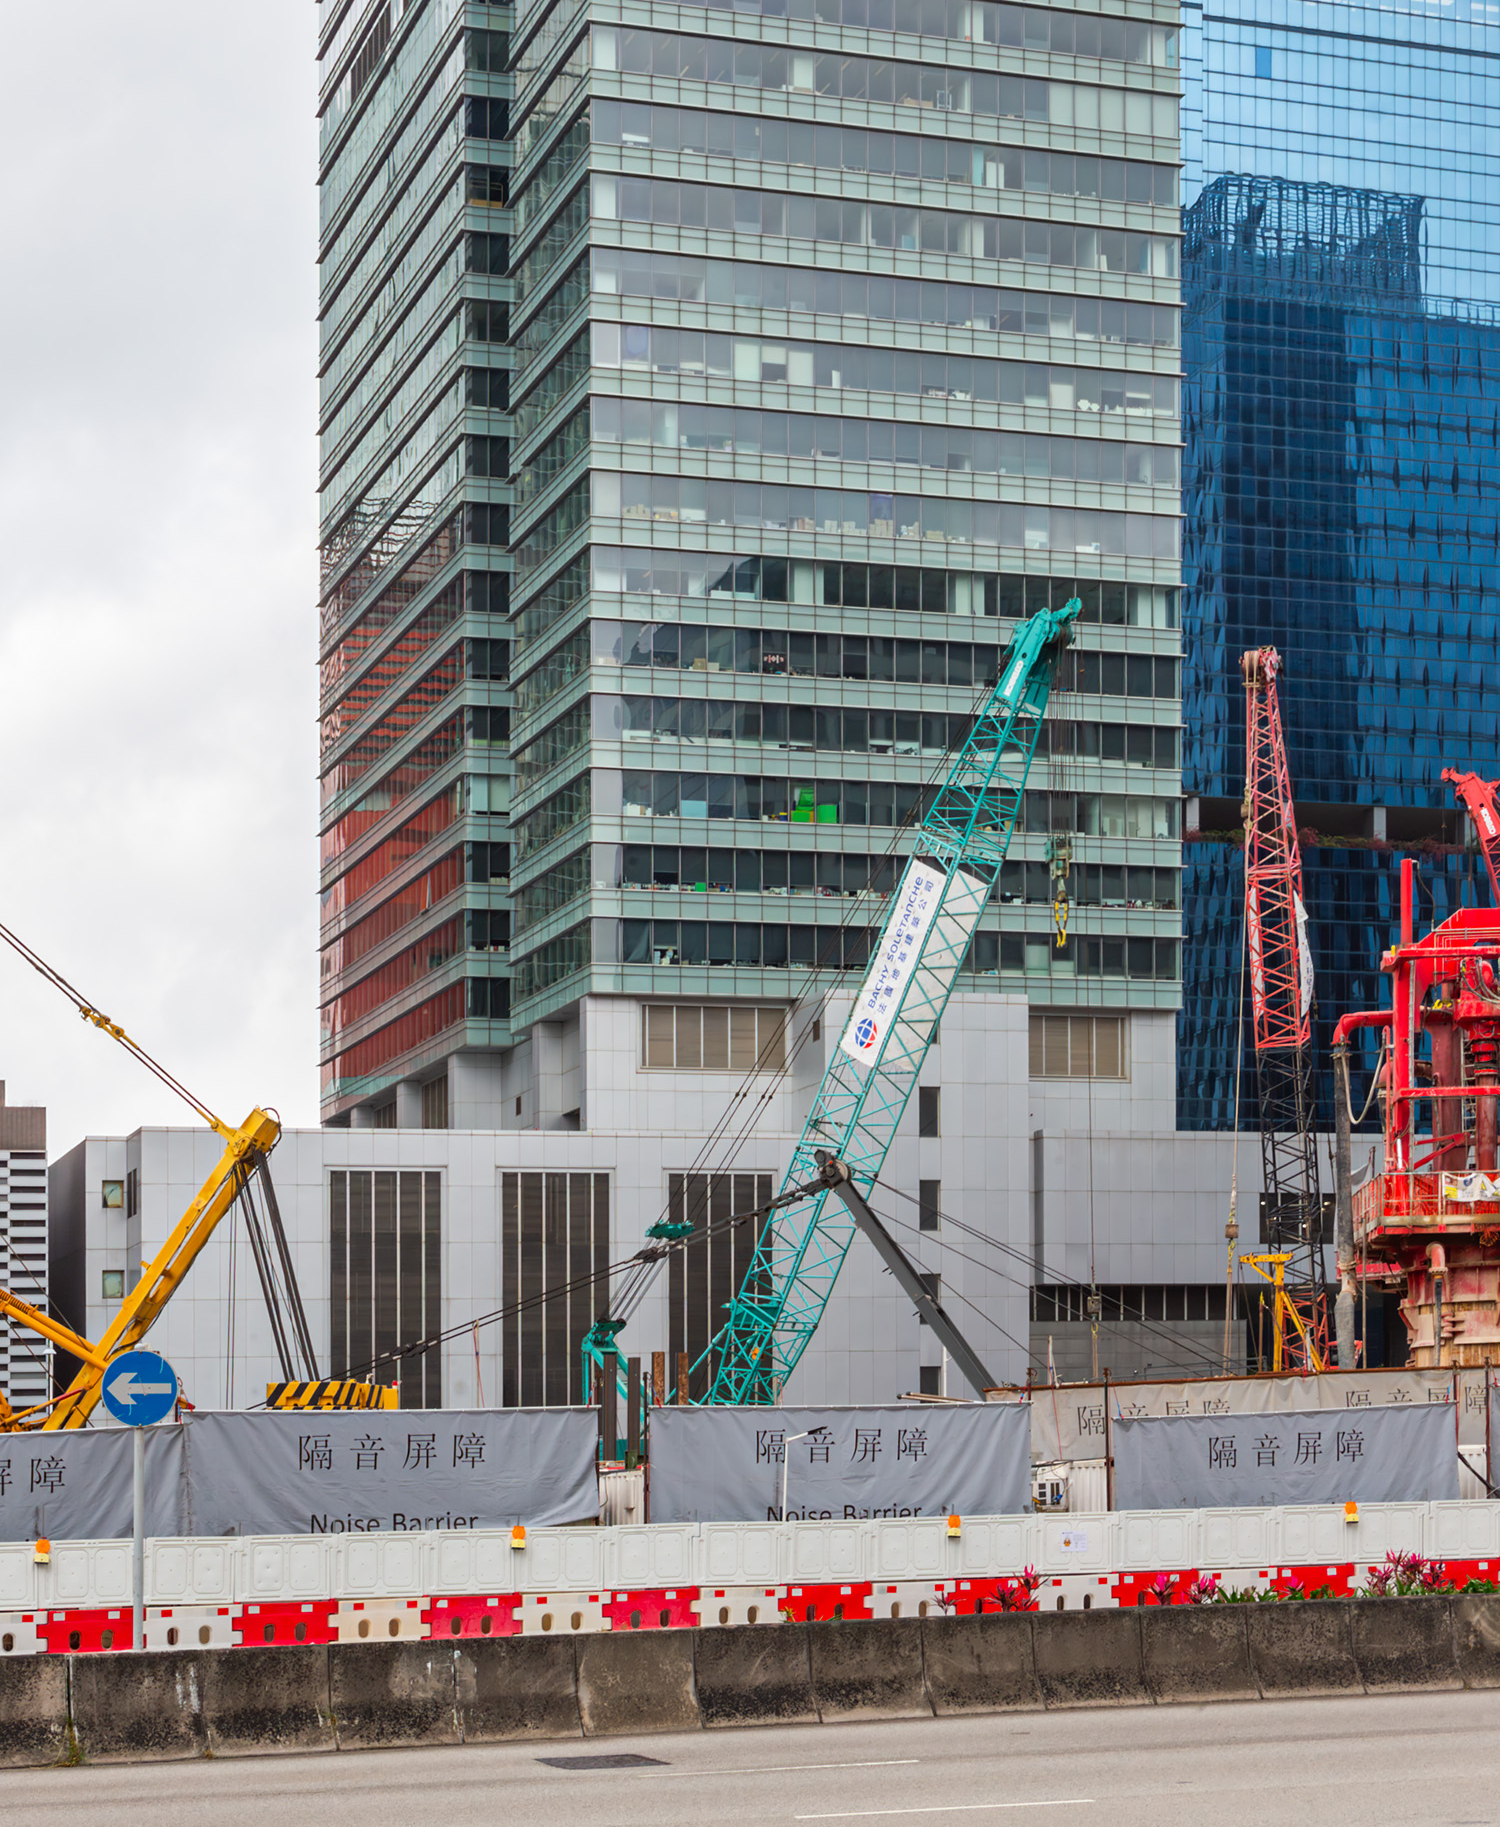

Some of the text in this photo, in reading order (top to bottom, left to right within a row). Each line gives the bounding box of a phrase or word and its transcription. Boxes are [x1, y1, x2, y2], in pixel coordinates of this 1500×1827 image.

[868, 966, 890, 1009] BACHY
[298, 1432, 488, 1471] 隔音屏障
[755, 1425, 929, 1465] 隔音屏障
[1208, 1428, 1366, 1469] 隔音屏障
[310, 1511, 479, 1534] Noise Barrier
[766, 1503, 922, 1522] Noise Barrier
